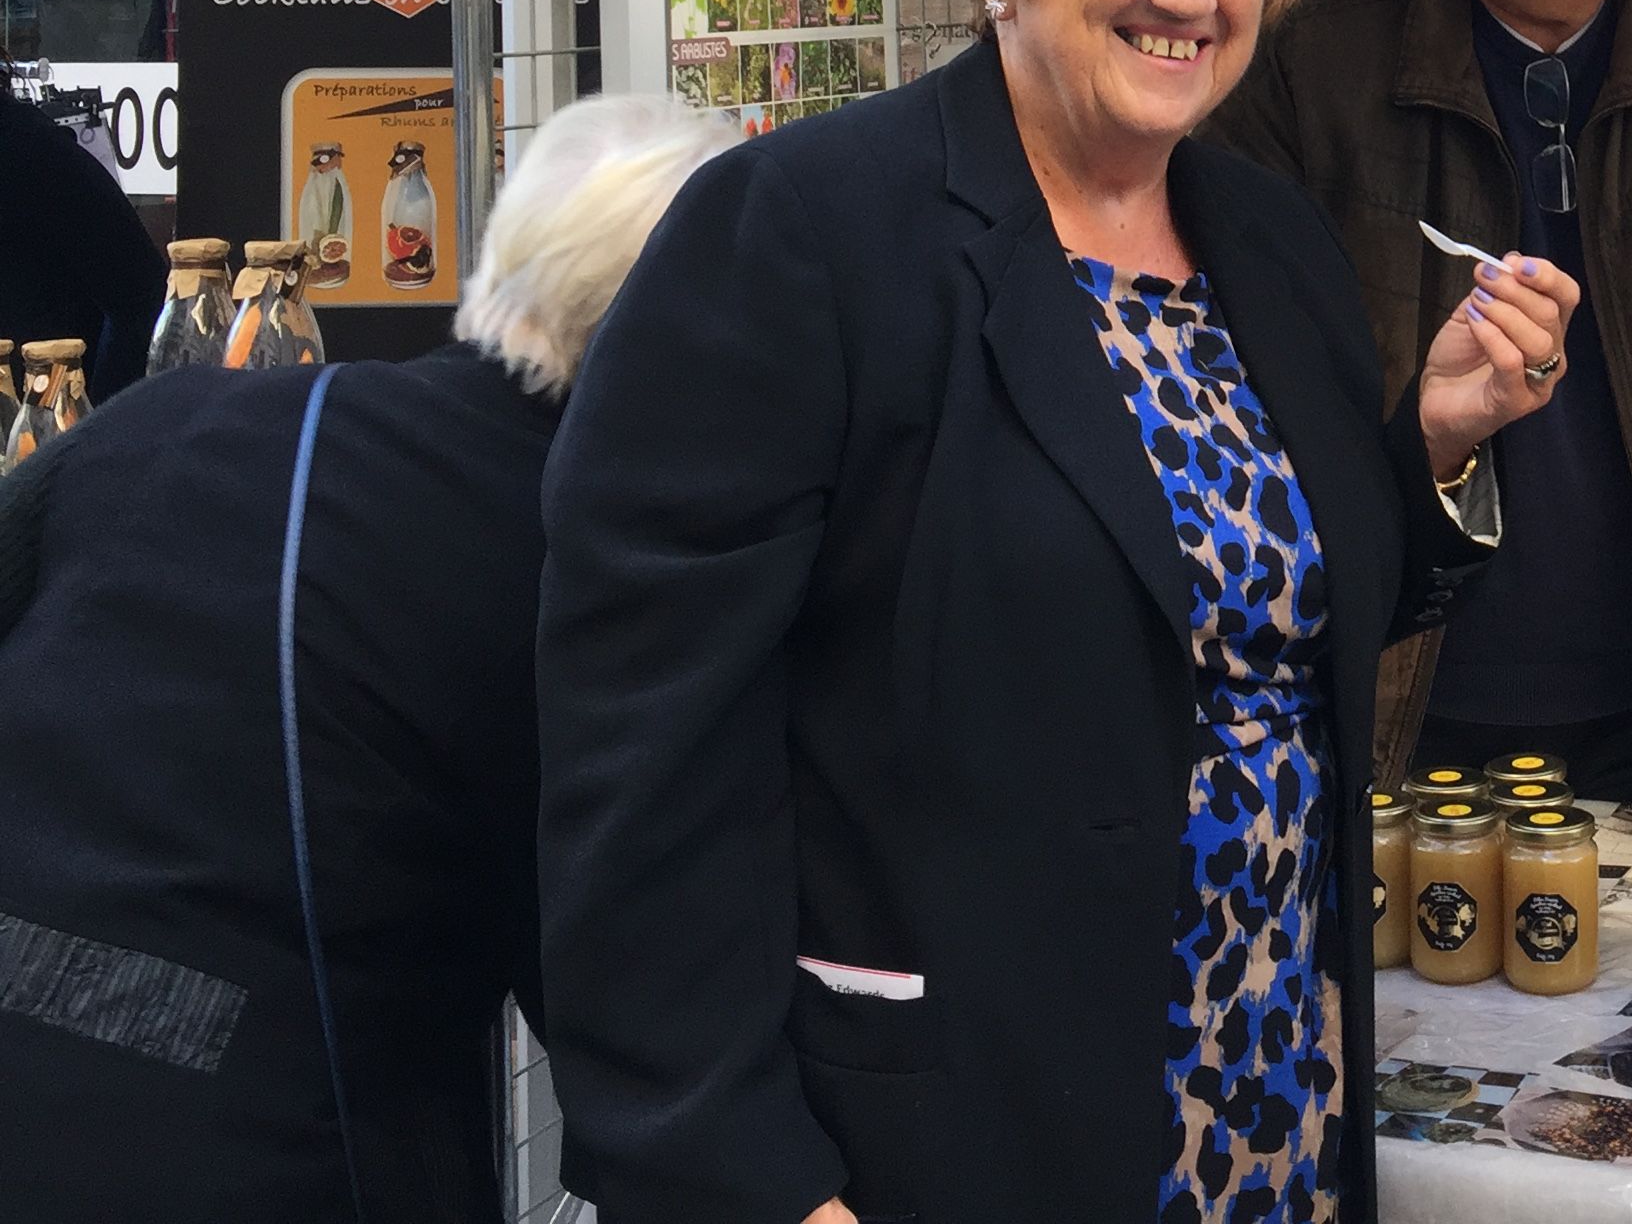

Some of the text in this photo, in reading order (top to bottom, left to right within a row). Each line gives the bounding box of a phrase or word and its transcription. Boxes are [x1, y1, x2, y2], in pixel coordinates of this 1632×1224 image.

[314, 83, 417, 101] Préparations
[414, 98, 444, 110] pour
[381, 116, 436, 127] Rhums
